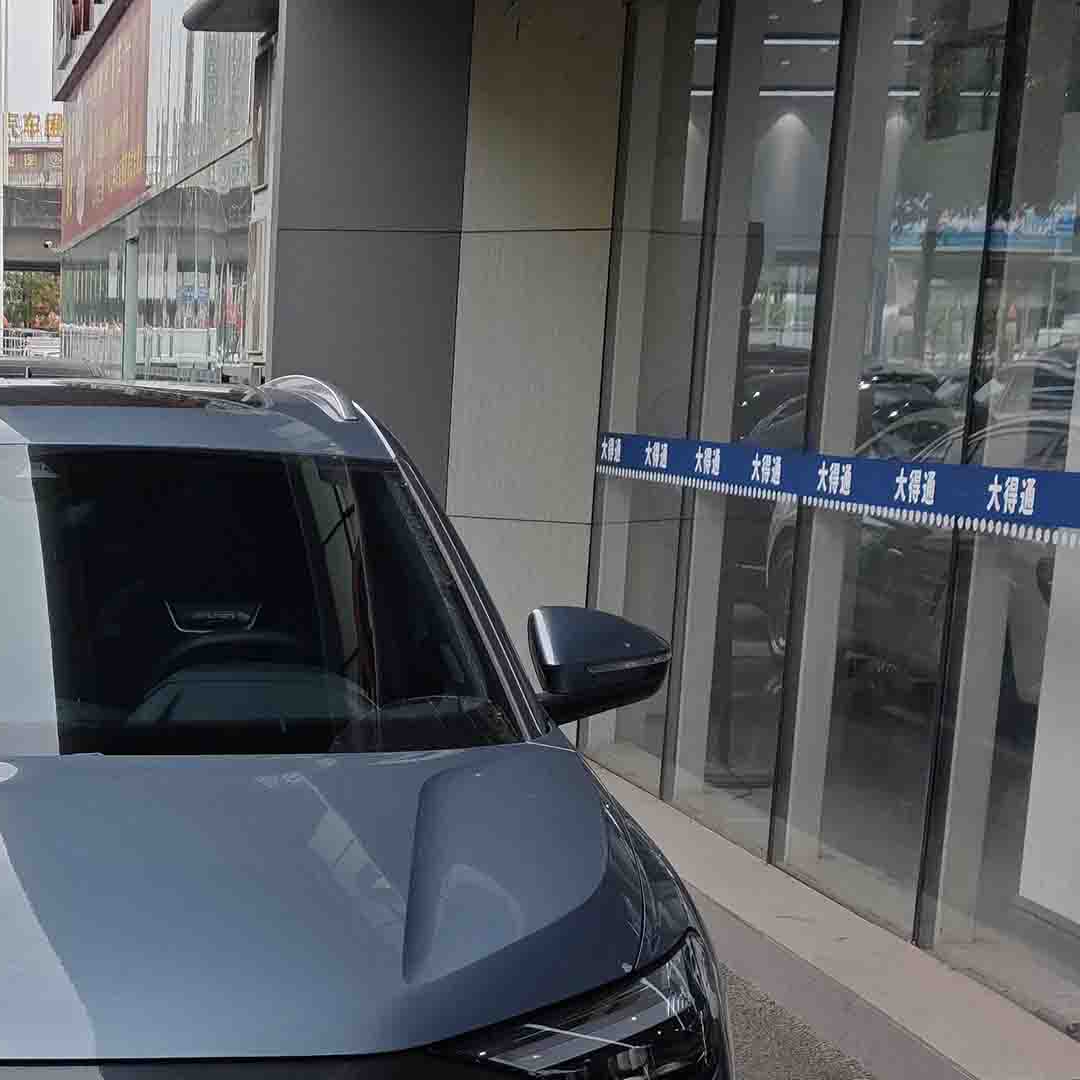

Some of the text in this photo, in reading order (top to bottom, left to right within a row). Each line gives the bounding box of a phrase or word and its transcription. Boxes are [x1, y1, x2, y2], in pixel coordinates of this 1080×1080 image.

[601, 437, 621, 463] 大得通
[644, 441, 668, 469] 大得通
[694, 446, 720, 476] 大得通
[751, 451, 782, 485] 大得通
[817, 460, 852, 496] 大得通
[894, 467, 936, 505] 大得通
[986, 474, 1036, 516] 大得通
